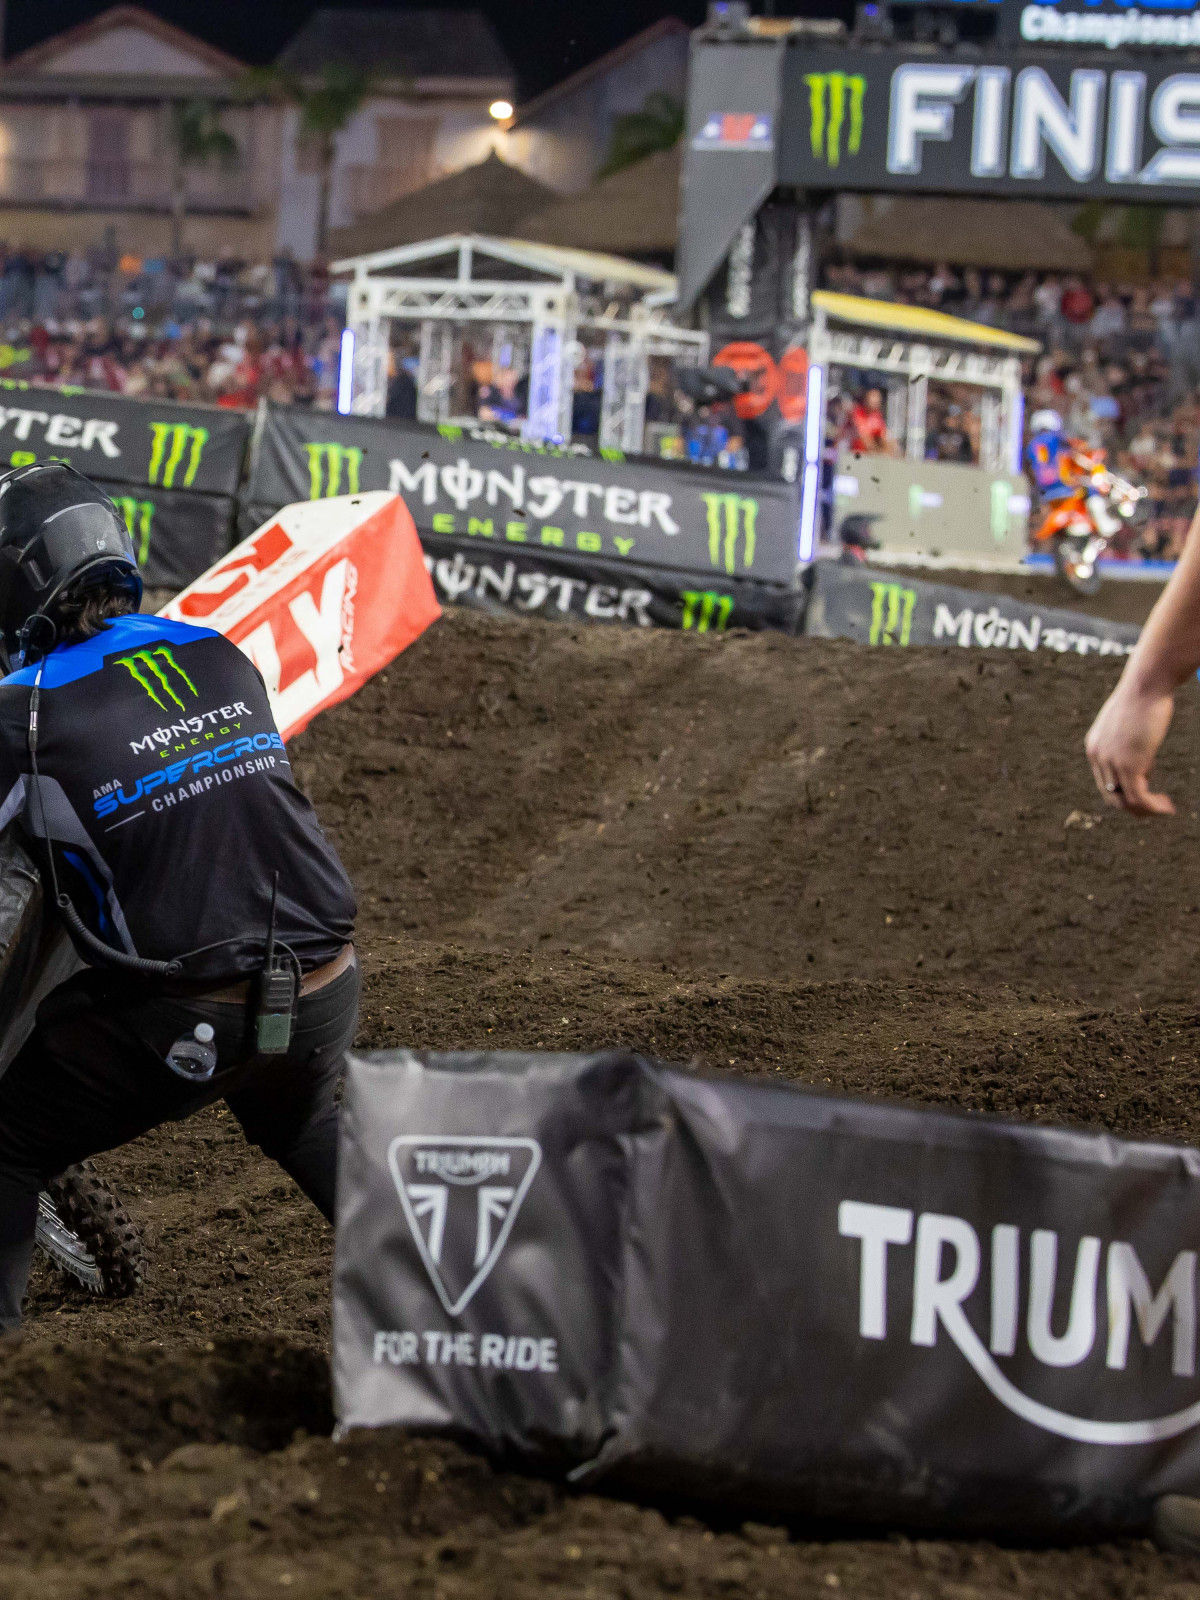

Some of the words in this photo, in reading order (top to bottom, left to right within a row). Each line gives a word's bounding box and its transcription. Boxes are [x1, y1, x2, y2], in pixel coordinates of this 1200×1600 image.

[1021, 4, 1200, 48] Champions
[389, 458, 681, 536] MONSTER
[432, 512, 636, 556] ENERGY
[424, 552, 655, 627] ONSTER
[128, 701, 253, 756] MONSTER
[159, 722, 243, 759] ENERGY
[92, 778, 123, 800] AMA
[151, 755, 277, 813] CHAMPIONSHIP
[413, 1151, 512, 1182] TRIUMPH
[837, 1199, 1199, 1405] TRIUM
[373, 1331, 420, 1366] FOR
[422, 1331, 477, 1367] THE
[479, 1332, 560, 1374] RIDE
